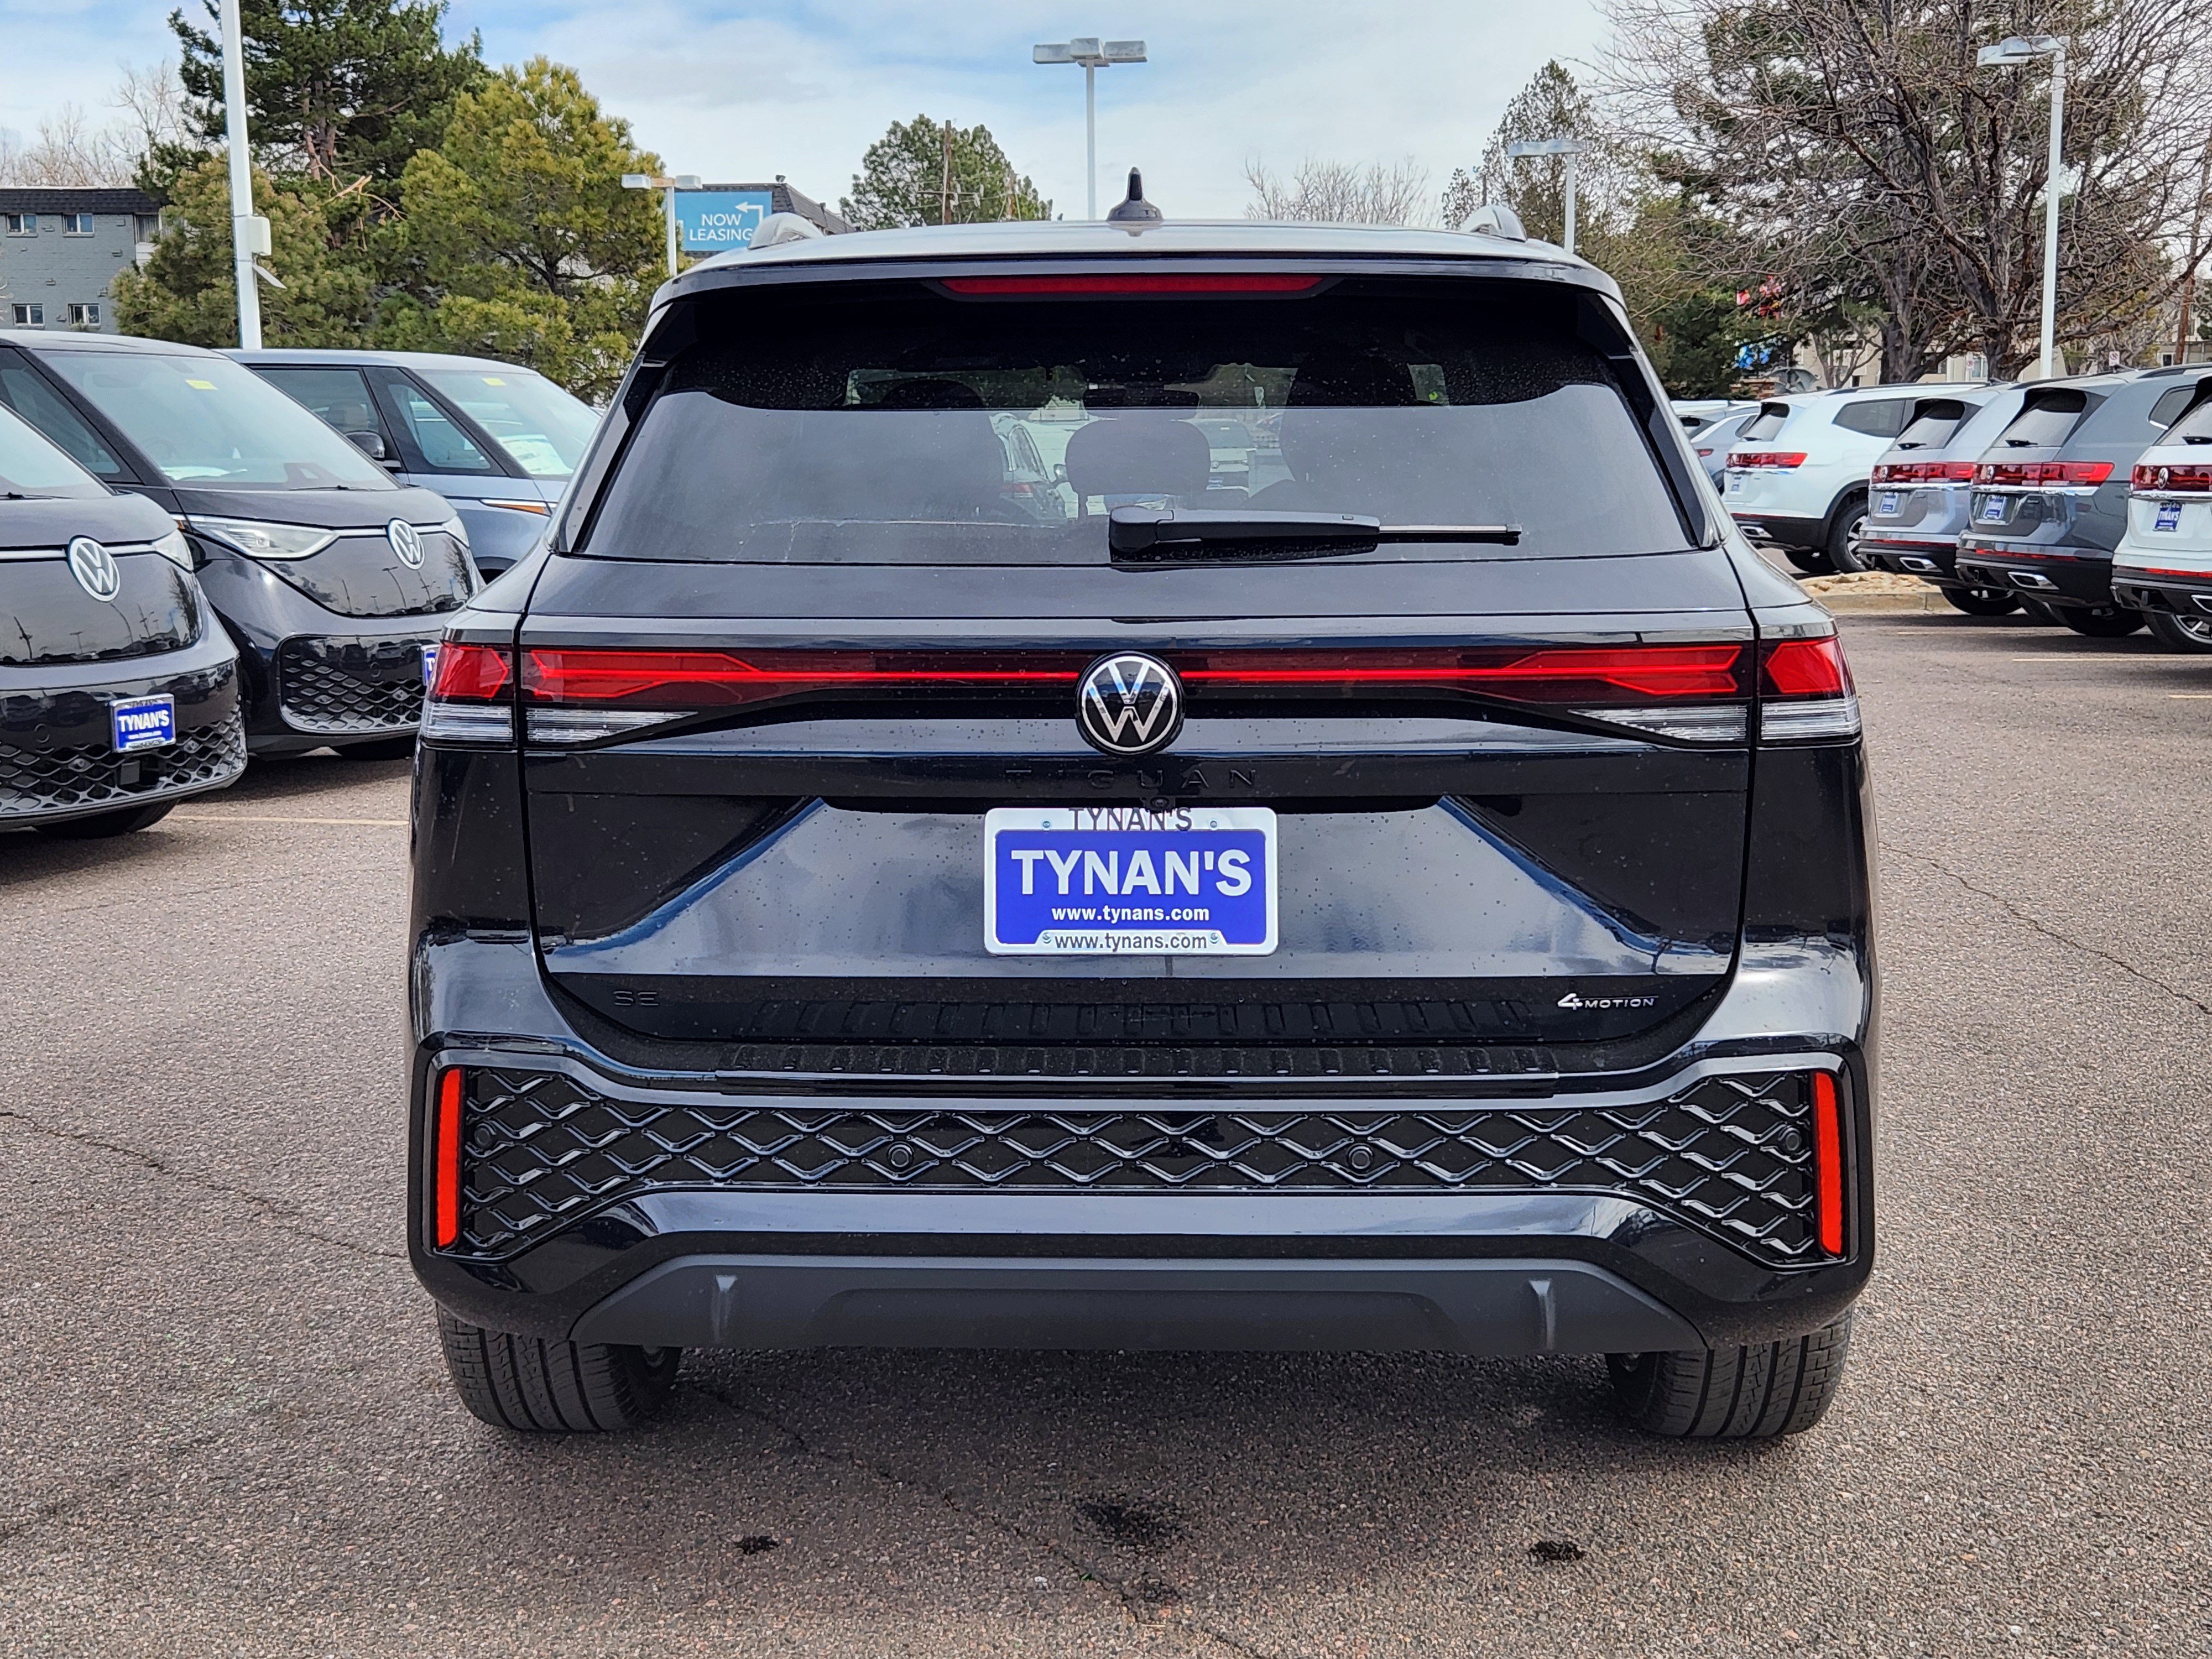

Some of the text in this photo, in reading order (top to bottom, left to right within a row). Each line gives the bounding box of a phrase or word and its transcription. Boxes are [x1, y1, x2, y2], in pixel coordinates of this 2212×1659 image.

[701, 214, 742, 226] NOW
[689, 228, 753, 241] LEASING
[392, 522, 422, 566] VW
[73, 540, 117, 597] VW
[1085, 659, 1173, 745] VW
[118, 709, 170, 733] TYNAN'S
[1005, 769, 1256, 789] TIGUAN
[1068, 807, 1192, 831] TYNAN'S
[1011, 849, 1251, 896] TYNAN'S
[1052, 905, 1209, 924] www.tynans.com
[1055, 932, 1207, 952] www.tynans.com
[613, 990, 659, 1006] SE
[1557, 993, 1655, 1010] 4MOTION
